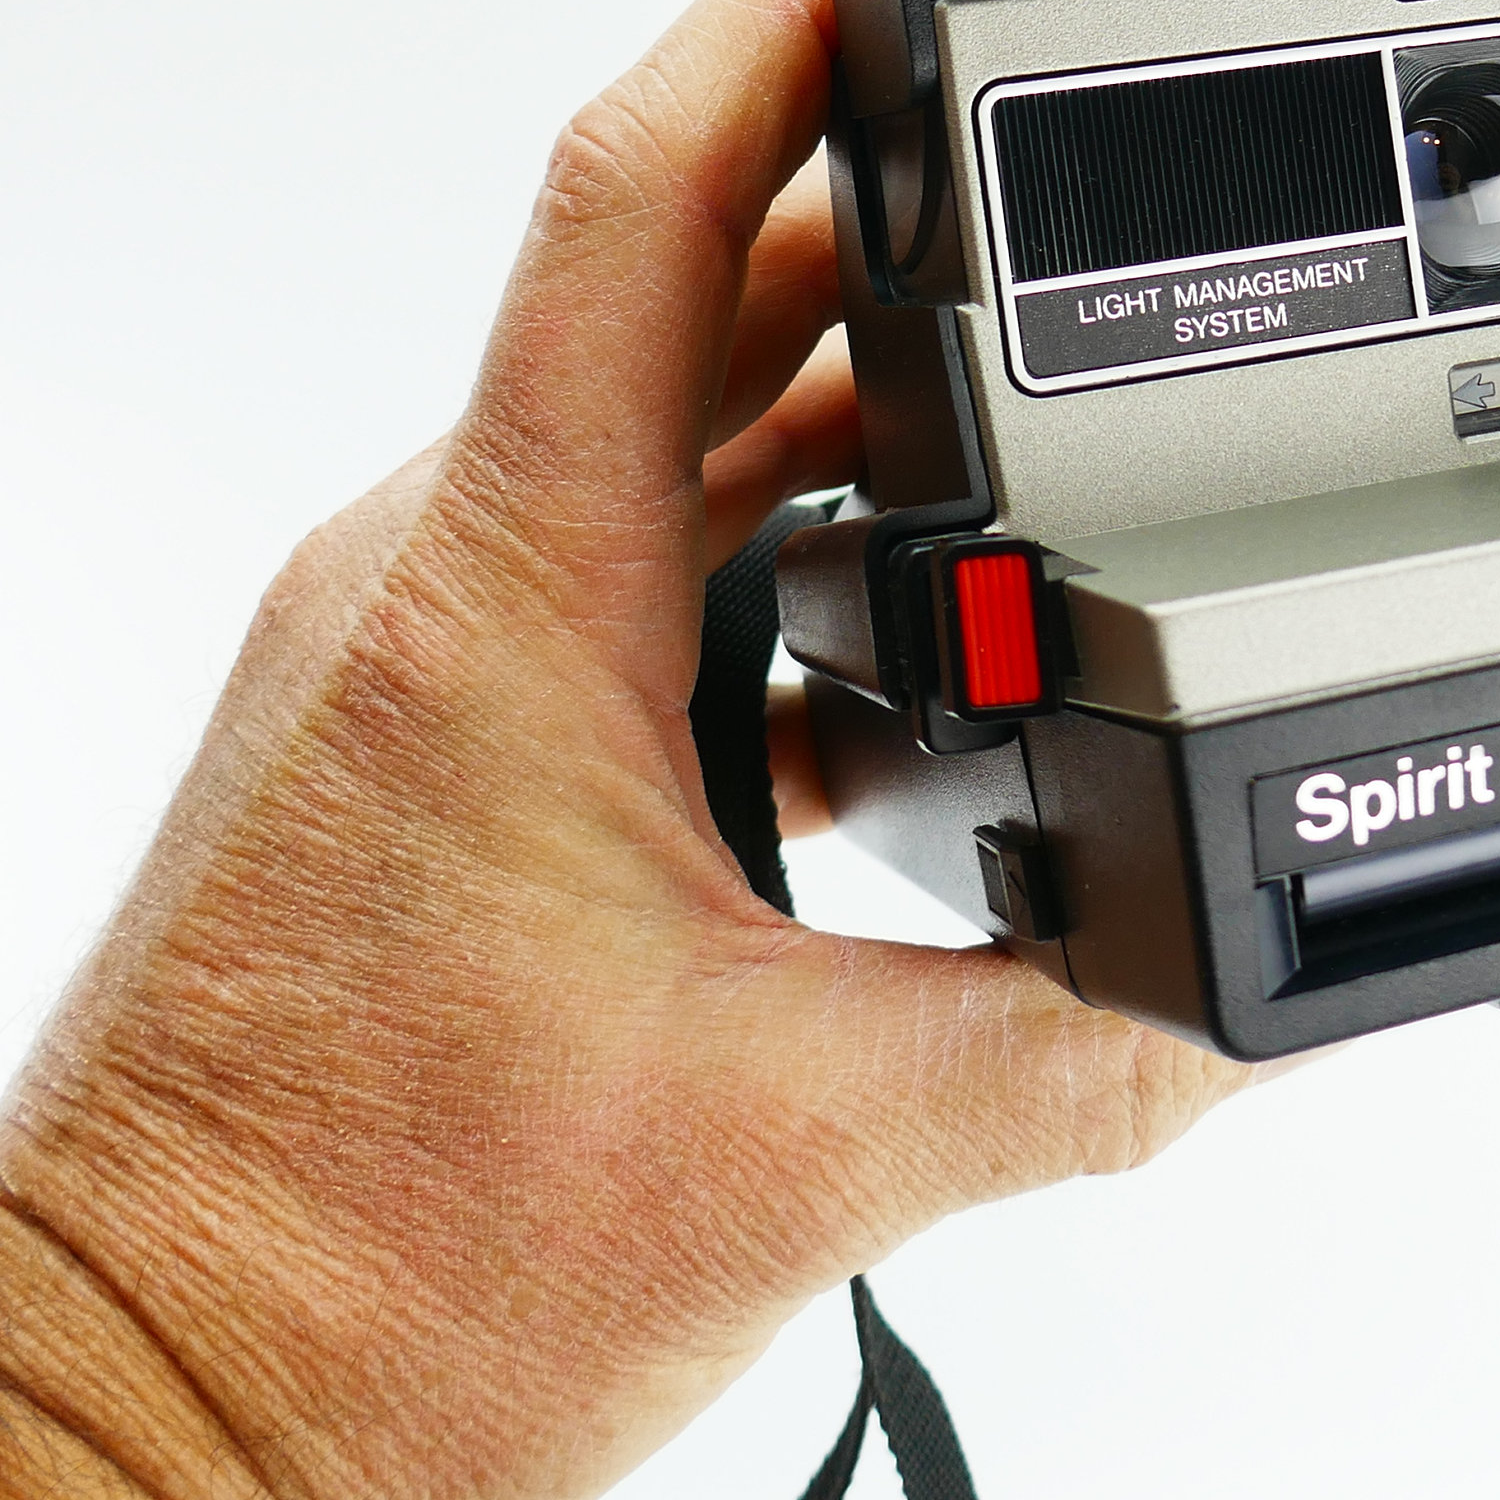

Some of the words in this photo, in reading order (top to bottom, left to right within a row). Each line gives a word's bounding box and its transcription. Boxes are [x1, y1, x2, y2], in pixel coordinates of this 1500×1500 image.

[1078, 286, 1163, 325] LIGHT
[1174, 257, 1369, 311] MANAGEMENT
[1174, 303, 1289, 344] SYSTEM
[1295, 743, 1495, 846] Spirit
